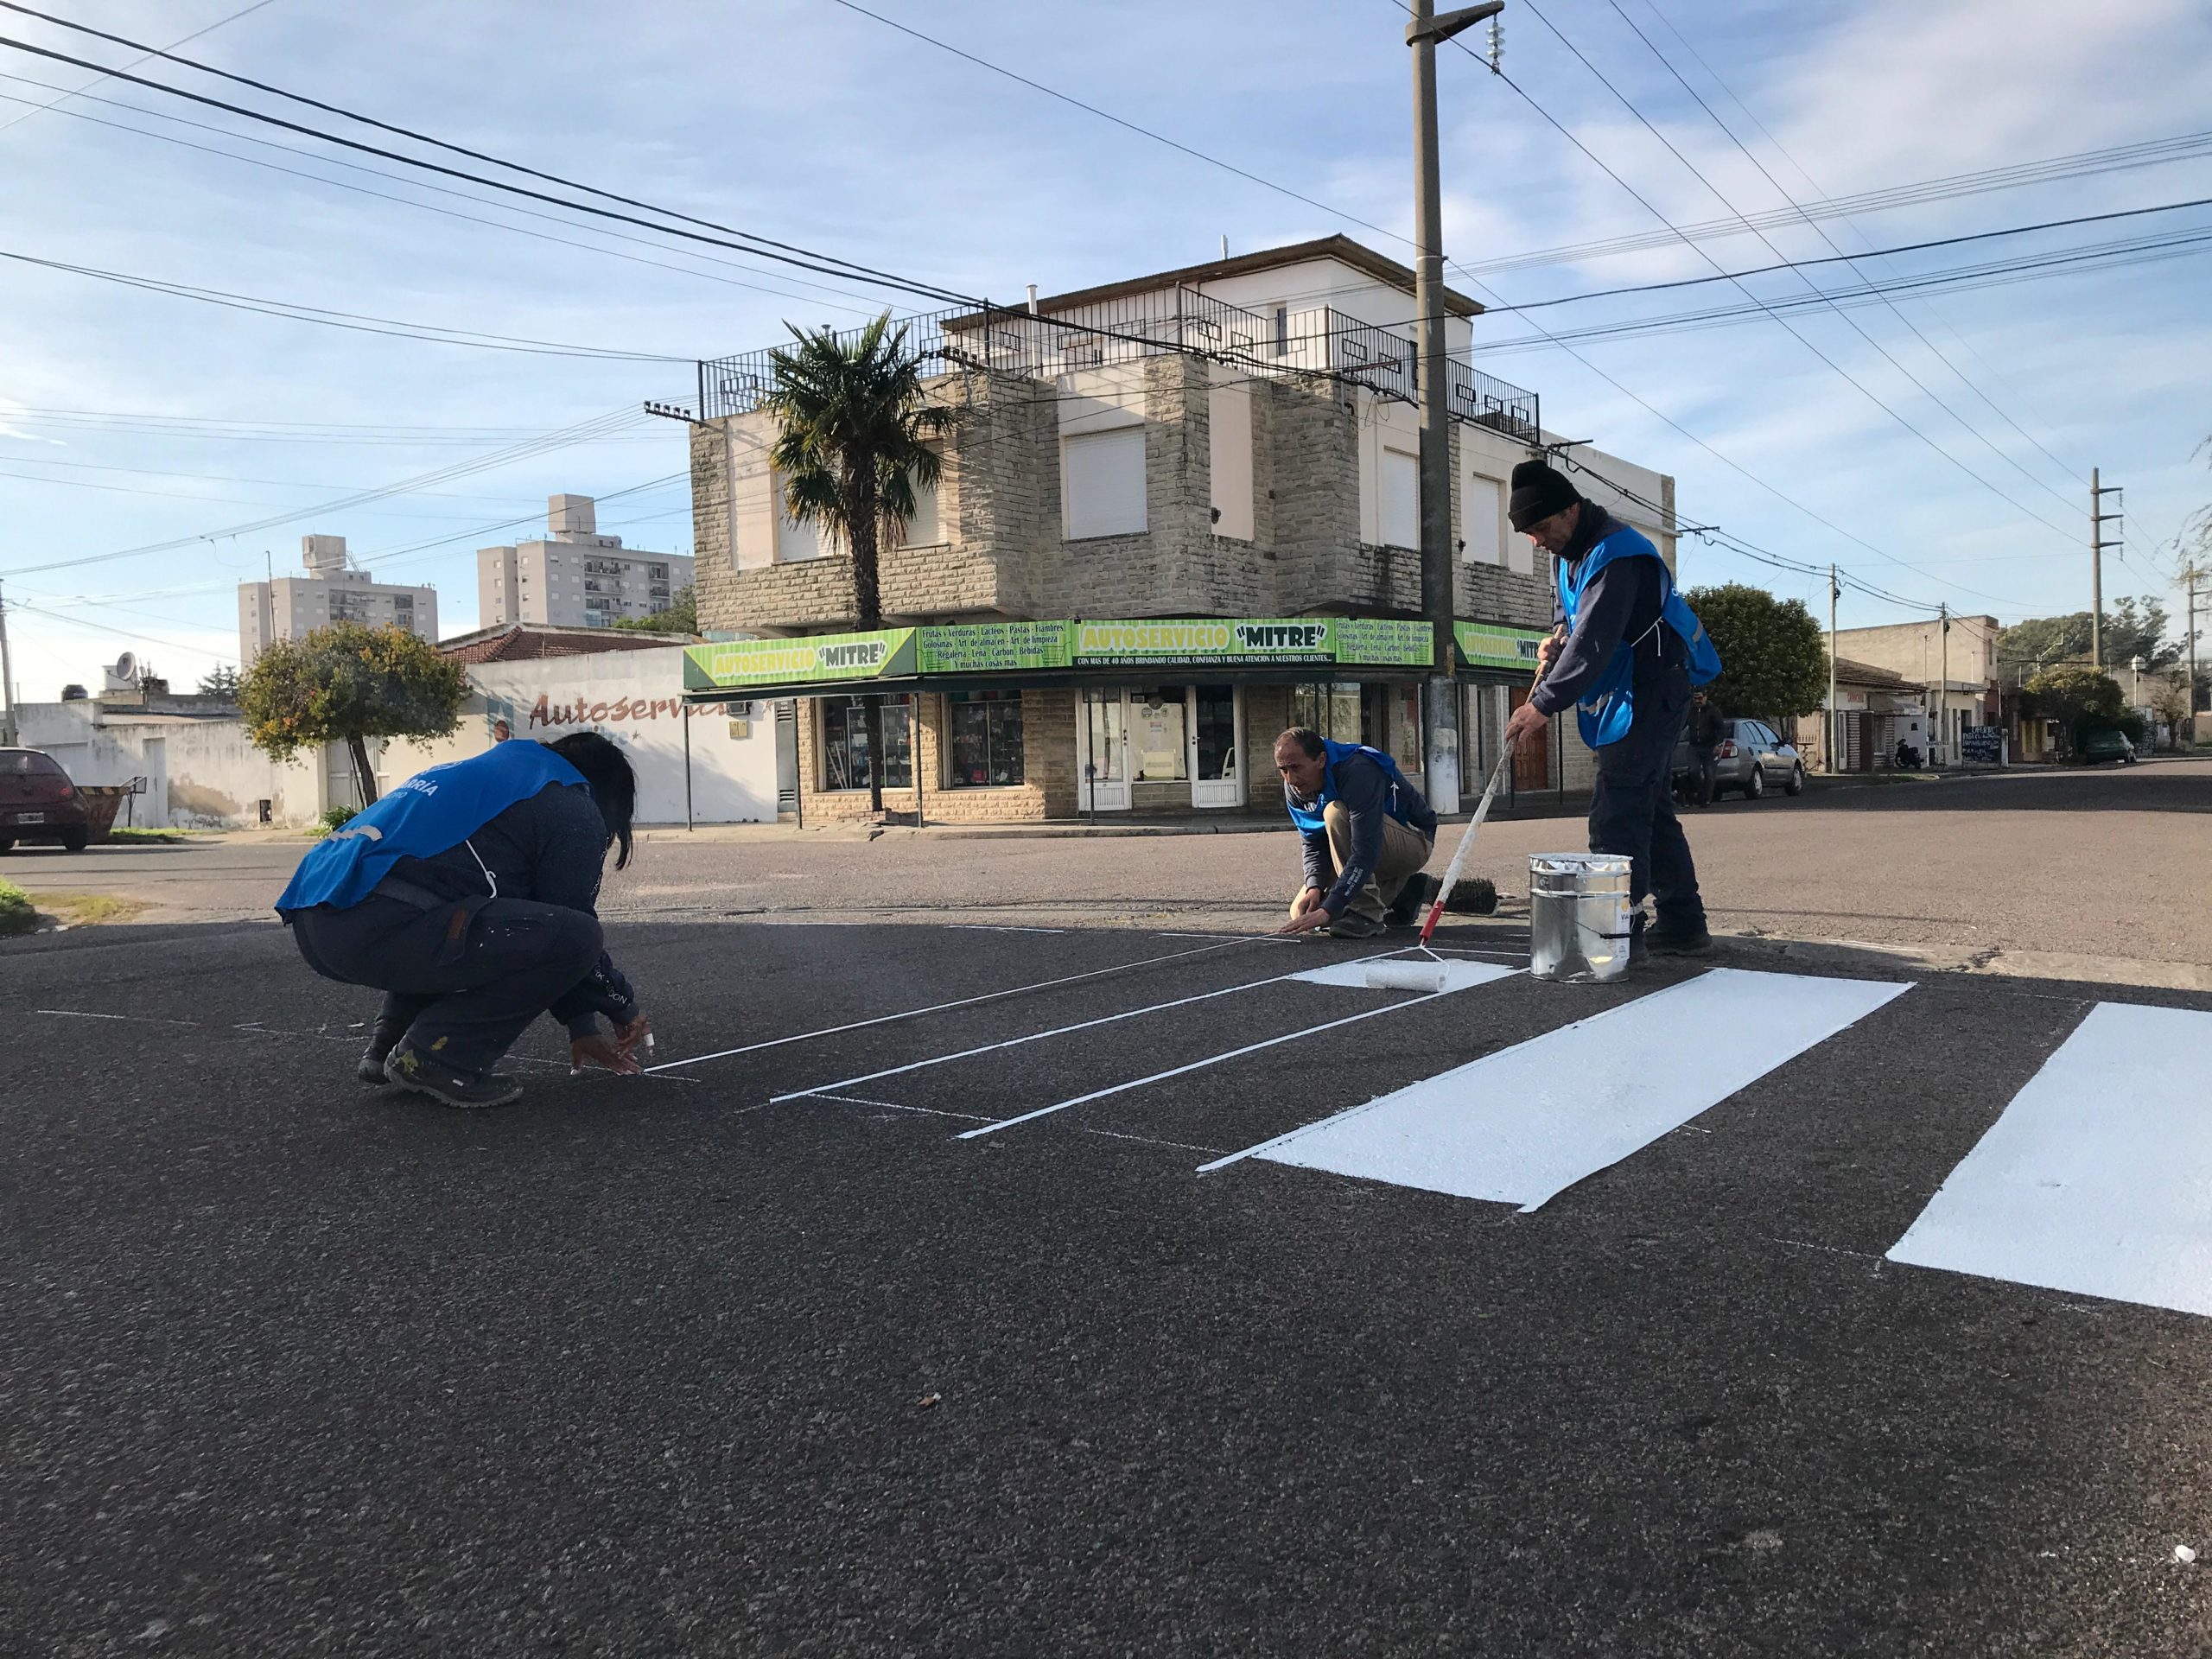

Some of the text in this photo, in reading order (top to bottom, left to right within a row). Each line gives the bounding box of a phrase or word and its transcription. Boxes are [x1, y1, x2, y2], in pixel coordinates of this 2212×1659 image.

[922, 629, 942, 638] Frutas
[949, 628, 976, 638] Verduras
[1009, 625, 1030, 634] Pastas
[1035, 624, 1064, 633] Fiambres
[1082, 625, 1325, 650] AUTOSERVICIO "MITRE"
[923, 639, 953, 649] Golosinas
[1032, 635, 1058, 645] limpieza
[971, 648, 987, 657] Leña
[1019, 645, 1044, 655] Bebidas
[715, 643, 887, 676] AUTOSERVICIO "MITRE"
[960, 659, 984, 669] muchas
[985, 659, 1002, 668] cosas
[1119, 655, 1135, 664] AÑOS
